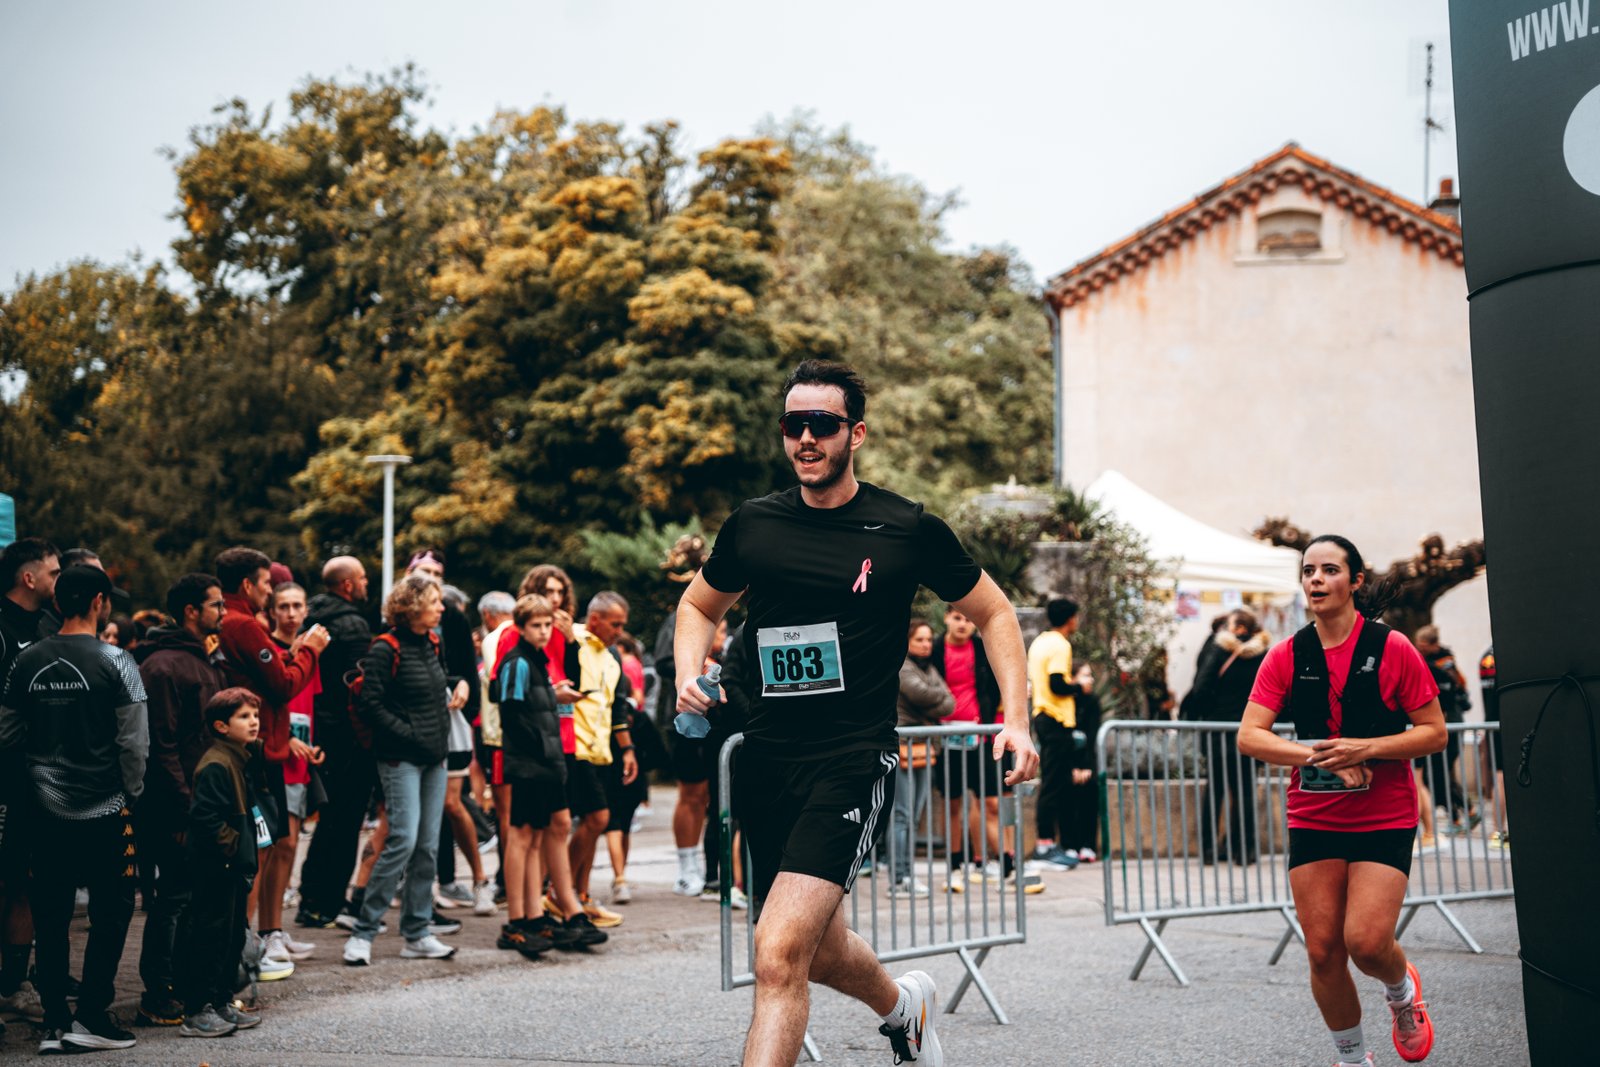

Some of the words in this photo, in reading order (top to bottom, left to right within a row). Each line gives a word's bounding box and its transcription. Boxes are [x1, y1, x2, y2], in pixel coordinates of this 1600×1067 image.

[1506, 0, 1600, 61] WWW.
[772, 646, 824, 682] 683
[50, 682, 83, 690] VALLON
